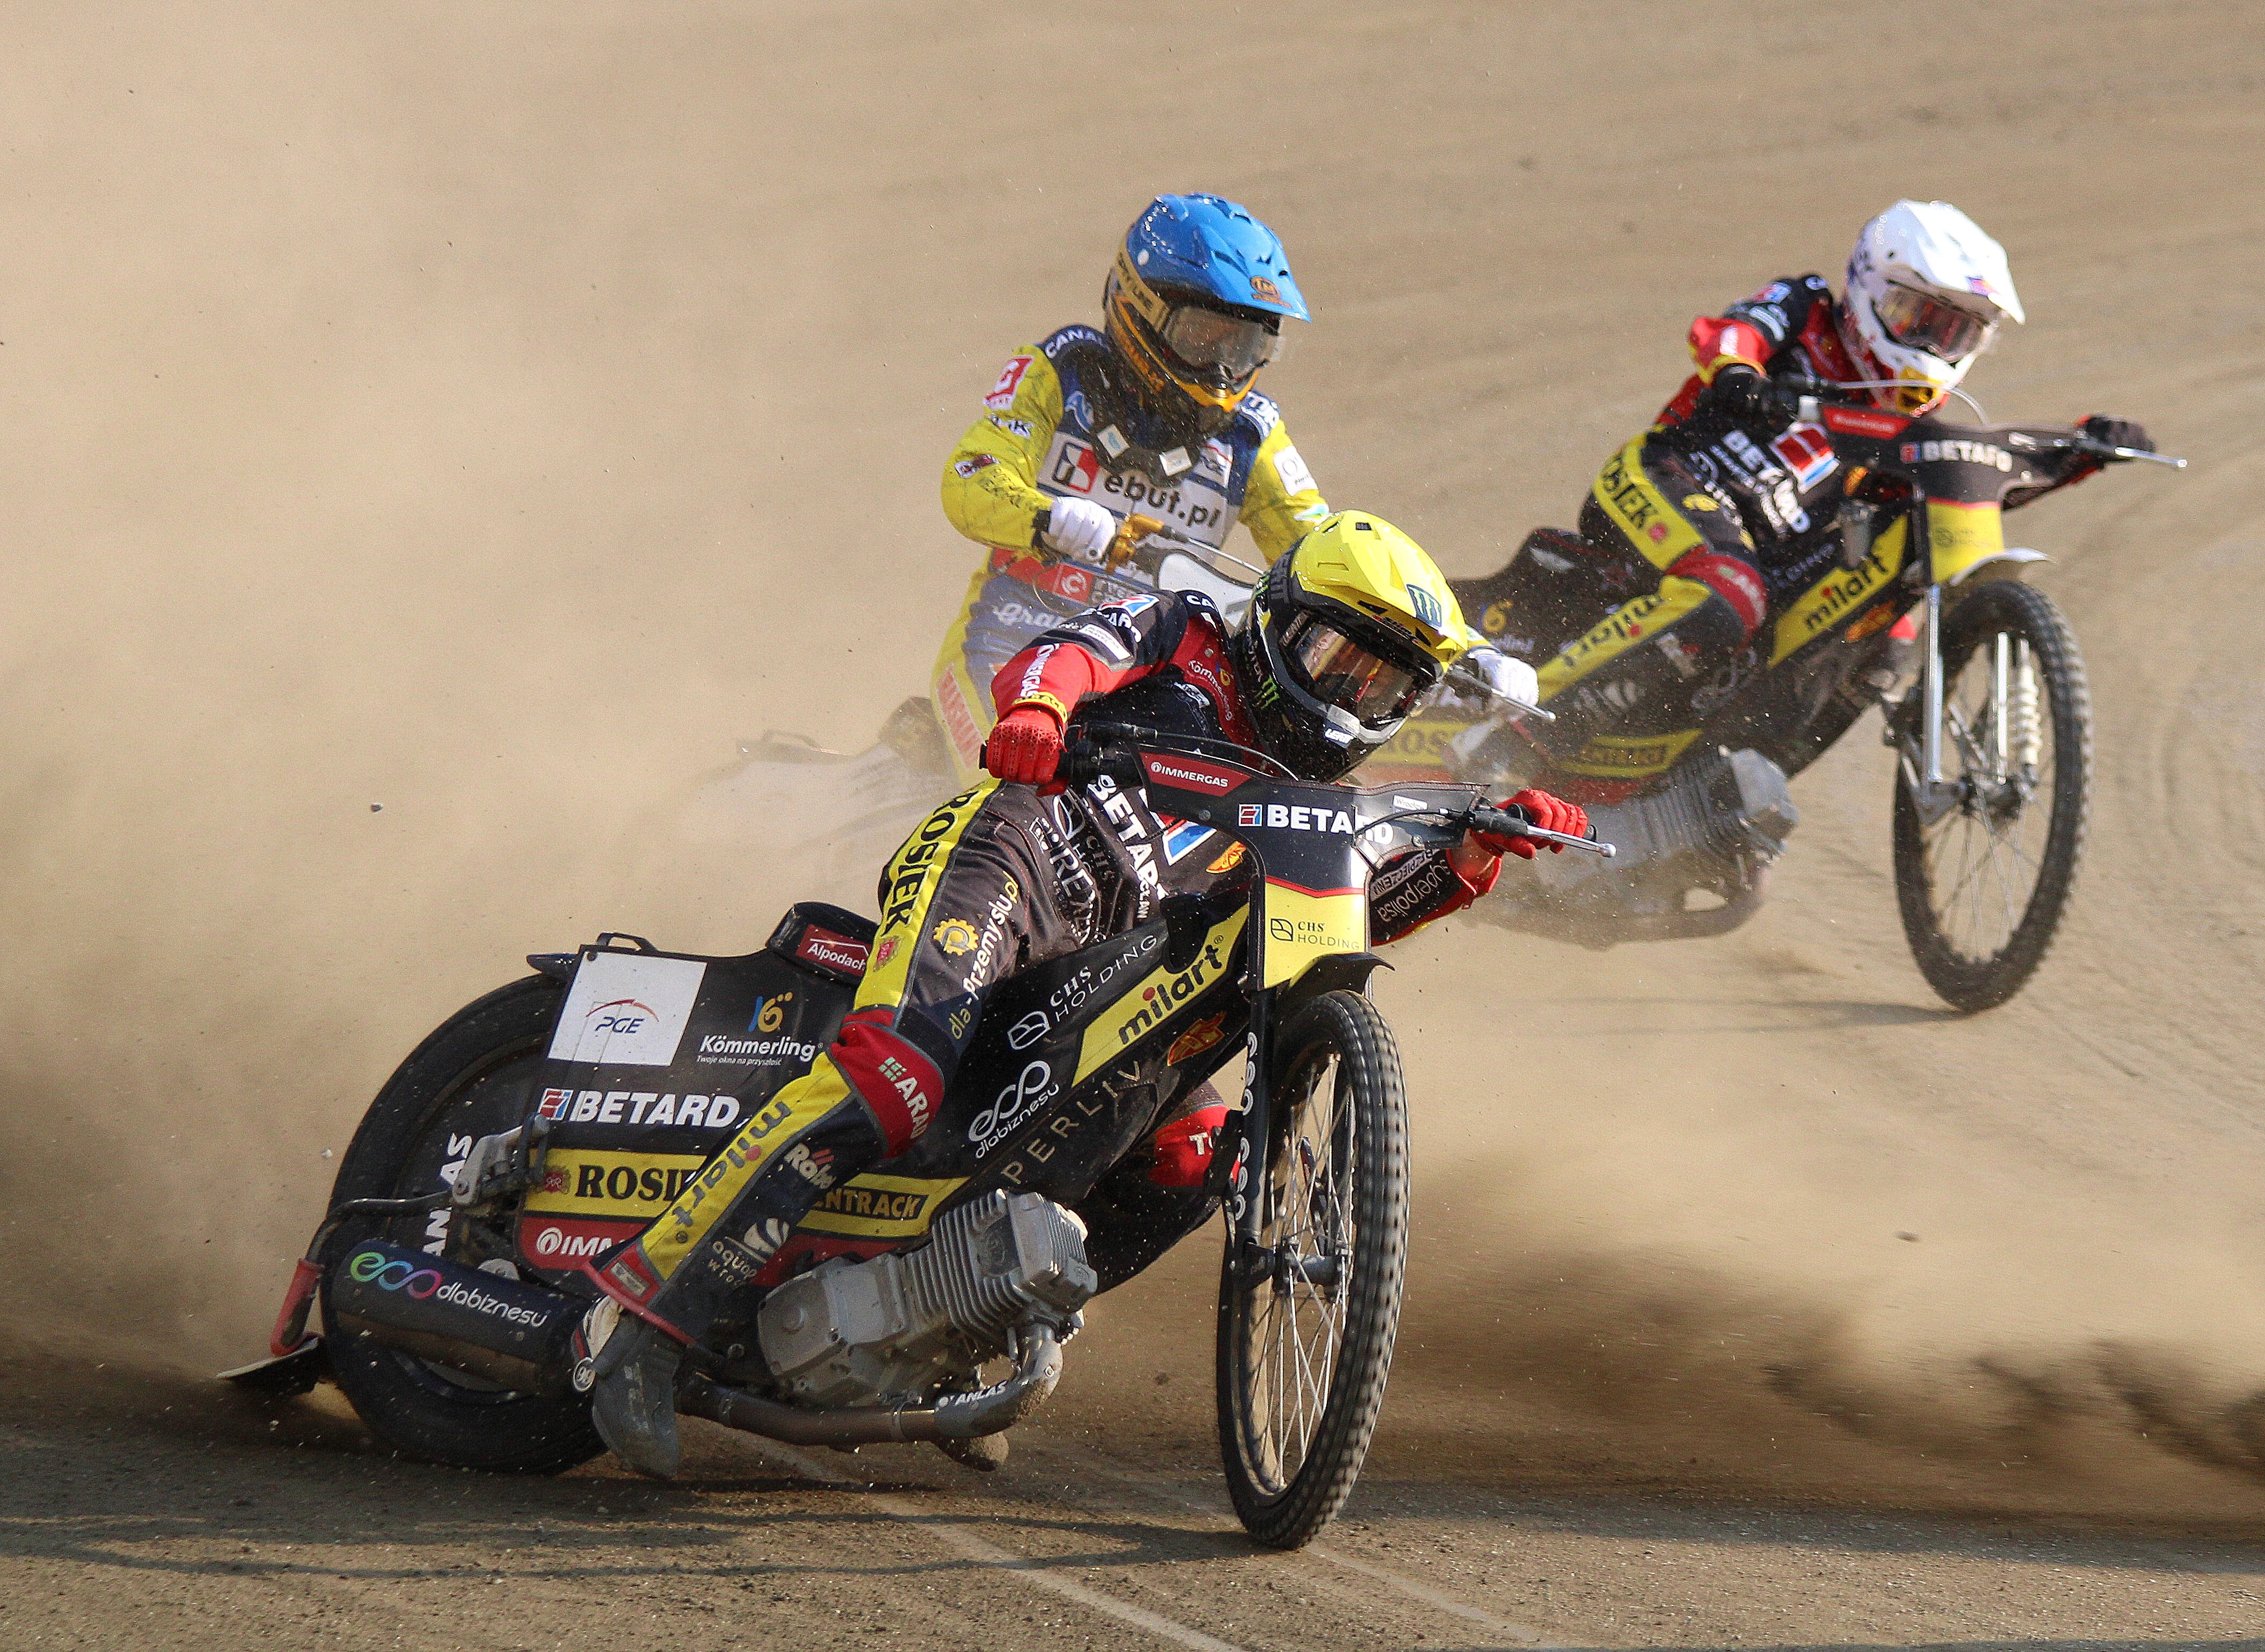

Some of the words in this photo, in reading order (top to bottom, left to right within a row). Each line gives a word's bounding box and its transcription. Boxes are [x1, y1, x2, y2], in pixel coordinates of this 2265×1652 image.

[1103, 470, 1219, 531] ebut.pl
[1161, 766, 1228, 788] IMMERGAS
[1267, 804, 1393, 844] BETARD
[1298, 921, 1325, 933] CHS
[1298, 934, 1360, 951] HOLDING
[1050, 965, 1092, 1008] CHS
[1055, 934, 1158, 1022] HOLDING
[1118, 944, 1222, 1045] milart
[594, 1017, 645, 1034] PGE
[699, 1035, 816, 1062] Kömmerling
[569, 1091, 741, 1128] BETARD
[975, 1083, 1060, 1159] dlabiznesu
[671, 1102, 793, 1228] milart
[813, 1187, 921, 1218] NTRACK
[435, 1282, 547, 1328] dlabiznesu
